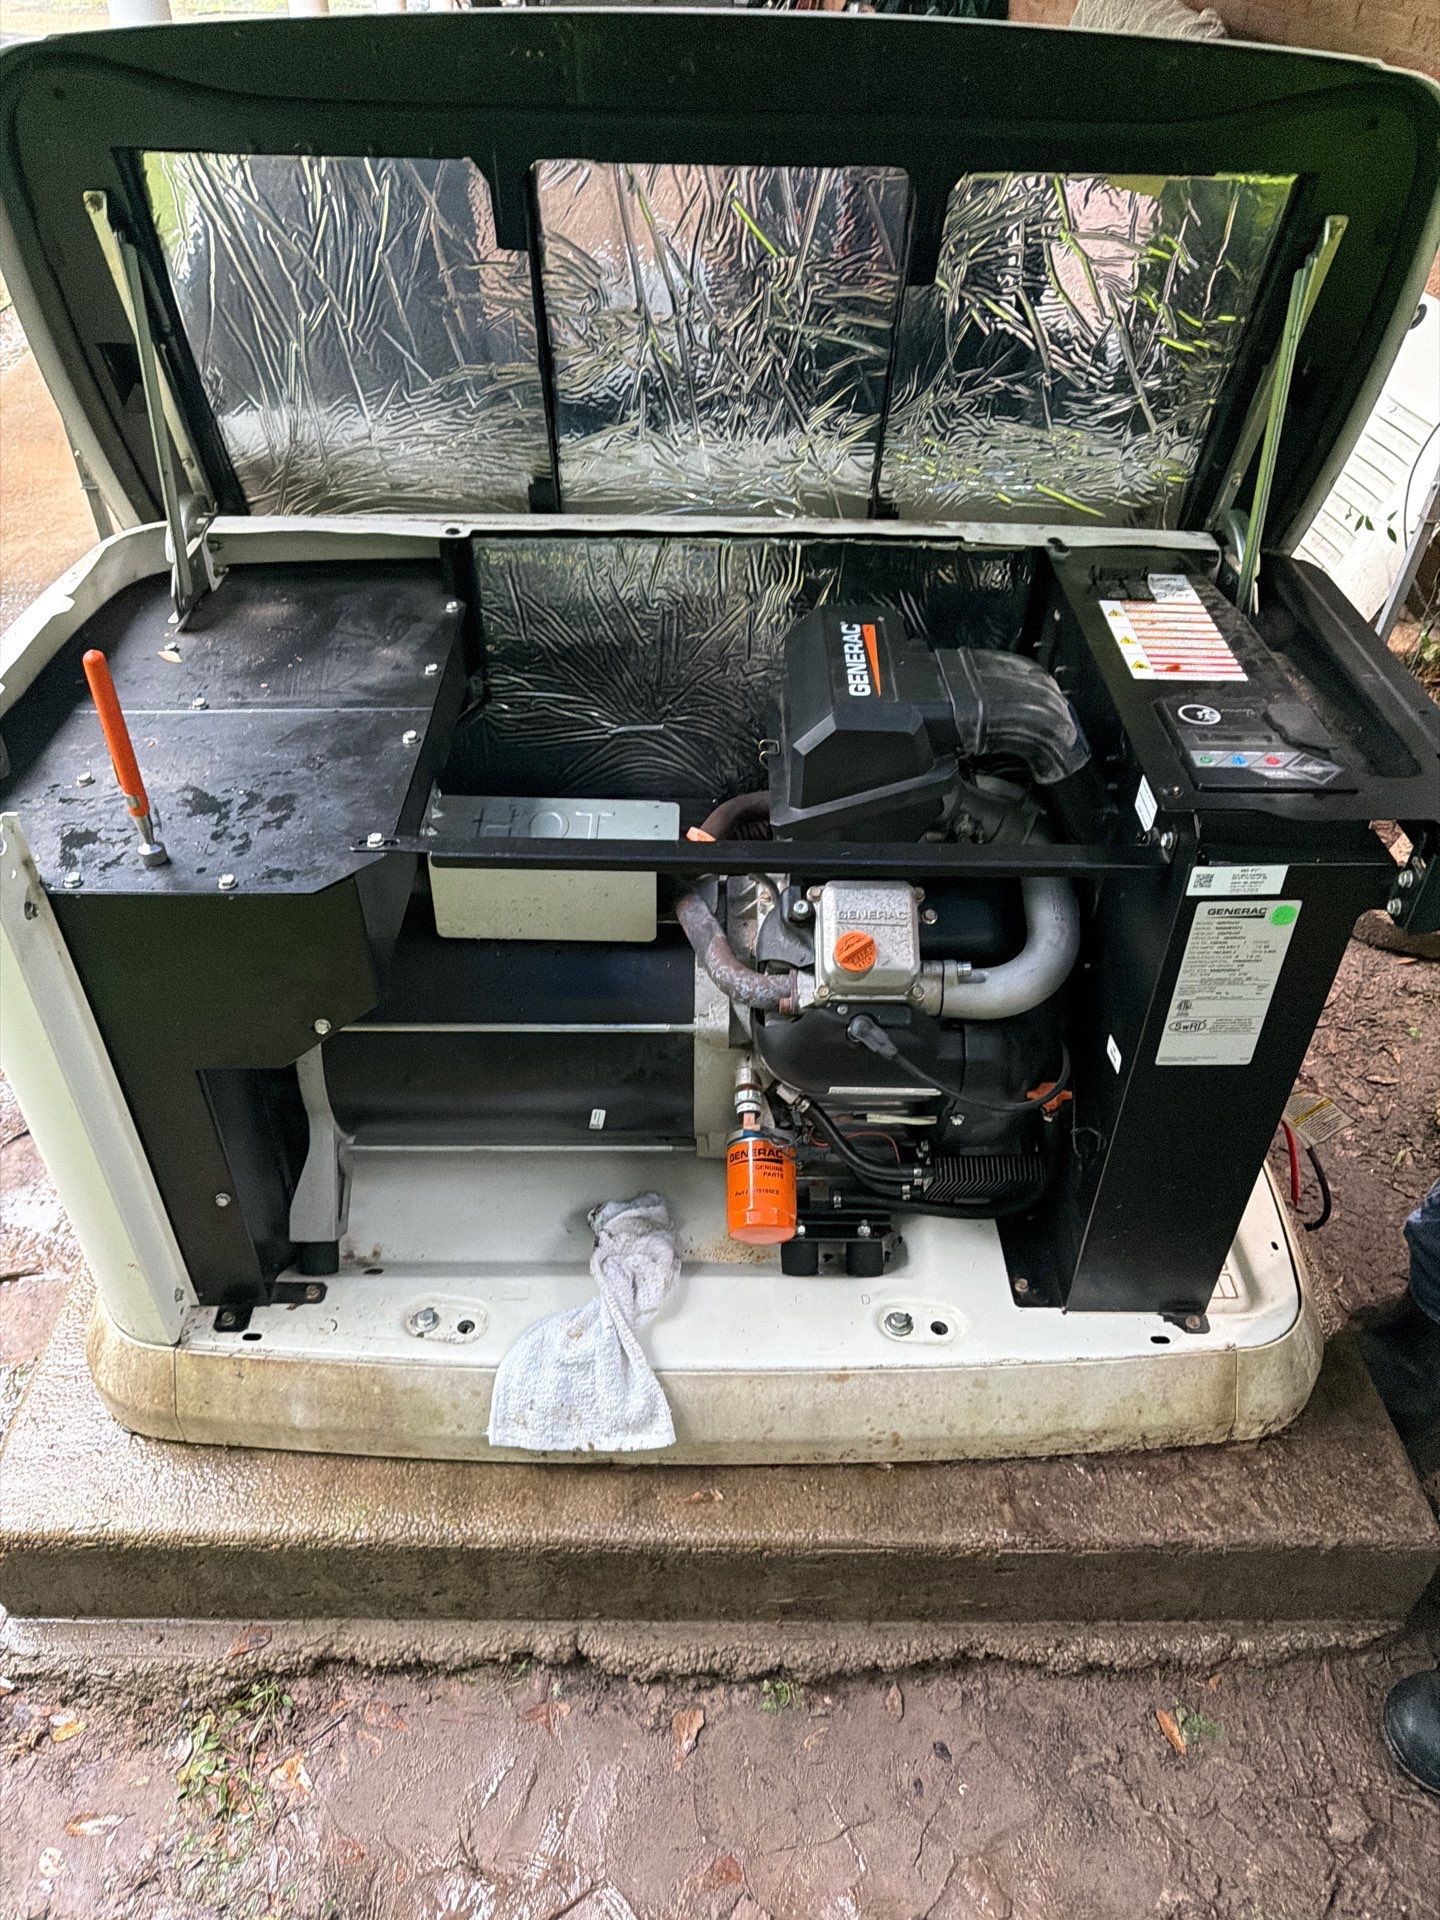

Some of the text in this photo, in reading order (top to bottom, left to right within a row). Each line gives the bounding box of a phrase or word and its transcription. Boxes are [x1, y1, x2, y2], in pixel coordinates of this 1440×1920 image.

[840, 623, 871, 697] GENERAC
[473, 803, 616, 839] HOT
[837, 909, 908, 921] GENERAC
[1207, 907, 1268, 916] GENERAC
[729, 1148, 784, 1163] GENERAC
[754, 1164, 784, 1173] GENUINE
[762, 1171, 784, 1180] PARTS
